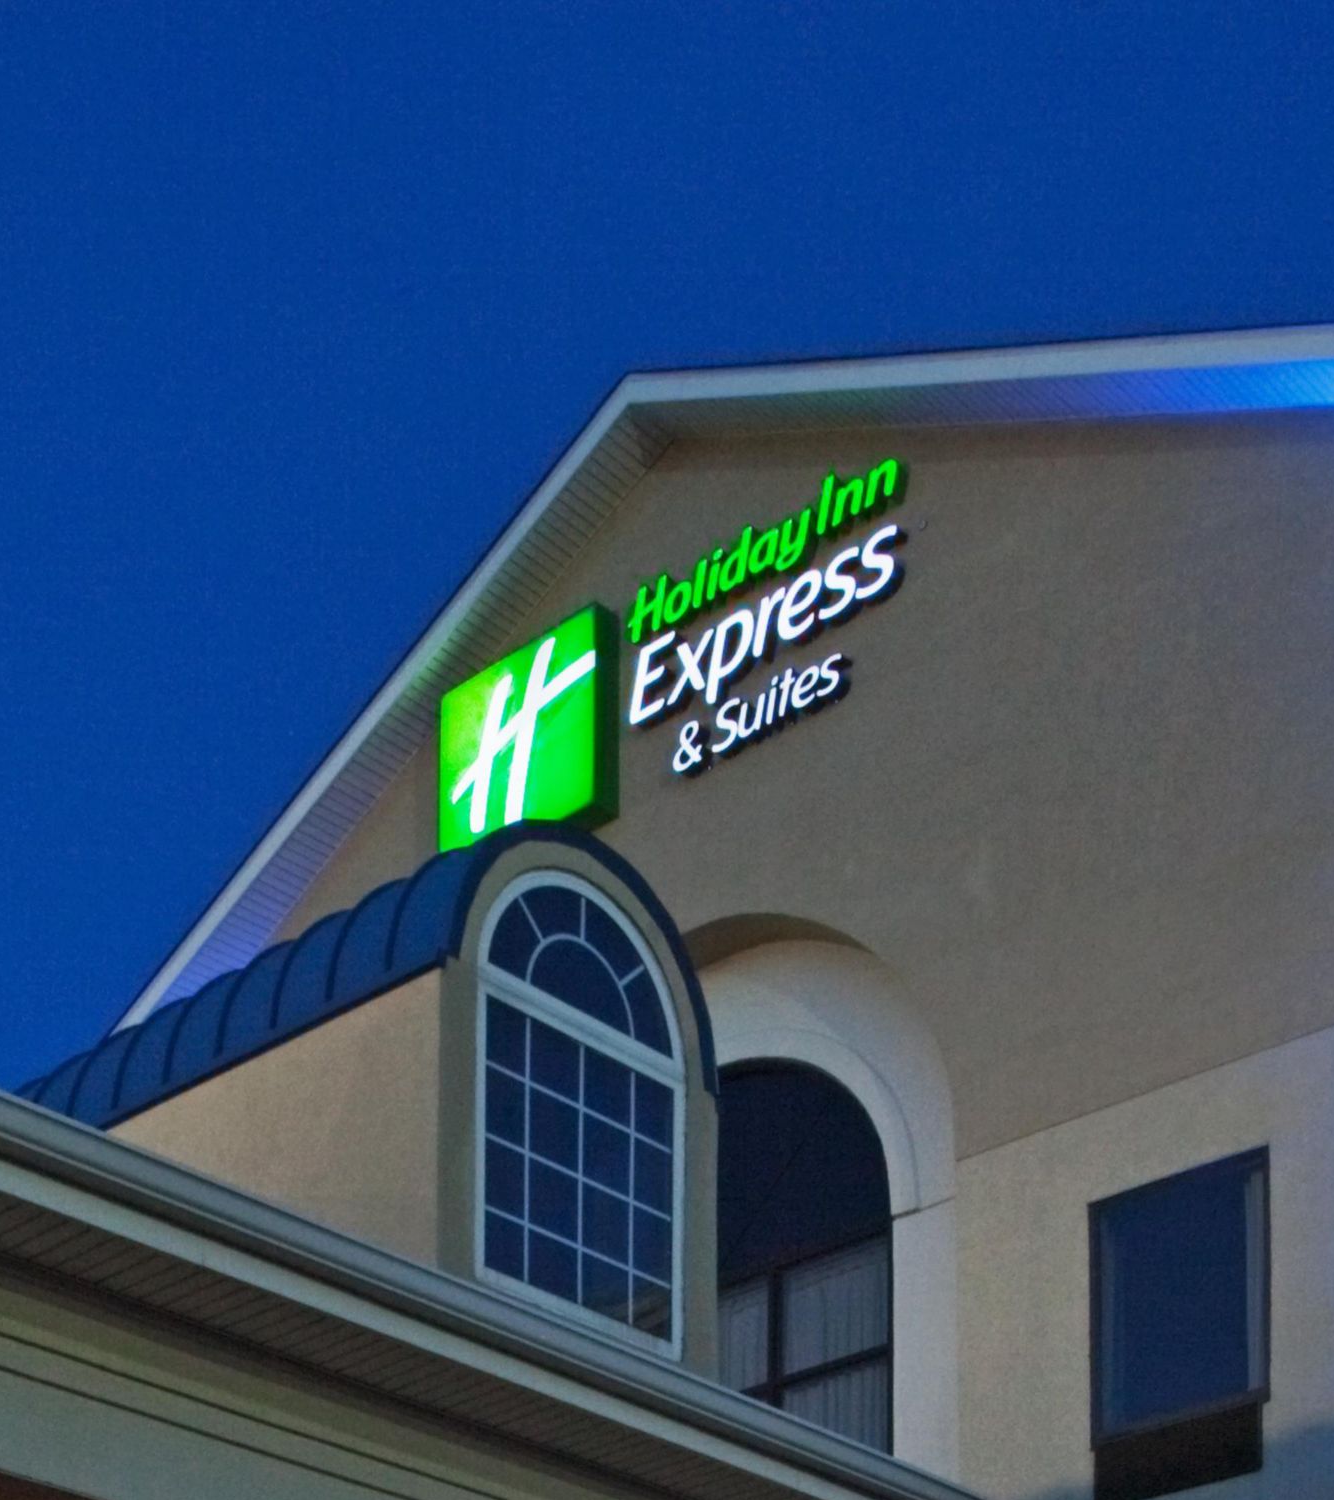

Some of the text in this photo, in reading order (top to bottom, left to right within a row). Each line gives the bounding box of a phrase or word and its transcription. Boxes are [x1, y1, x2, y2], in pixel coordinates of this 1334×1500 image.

[627, 457, 899, 643] Holiday Inn
[628, 524, 898, 725] Express
[450, 636, 596, 833] H
[672, 653, 843, 774] & Suites
